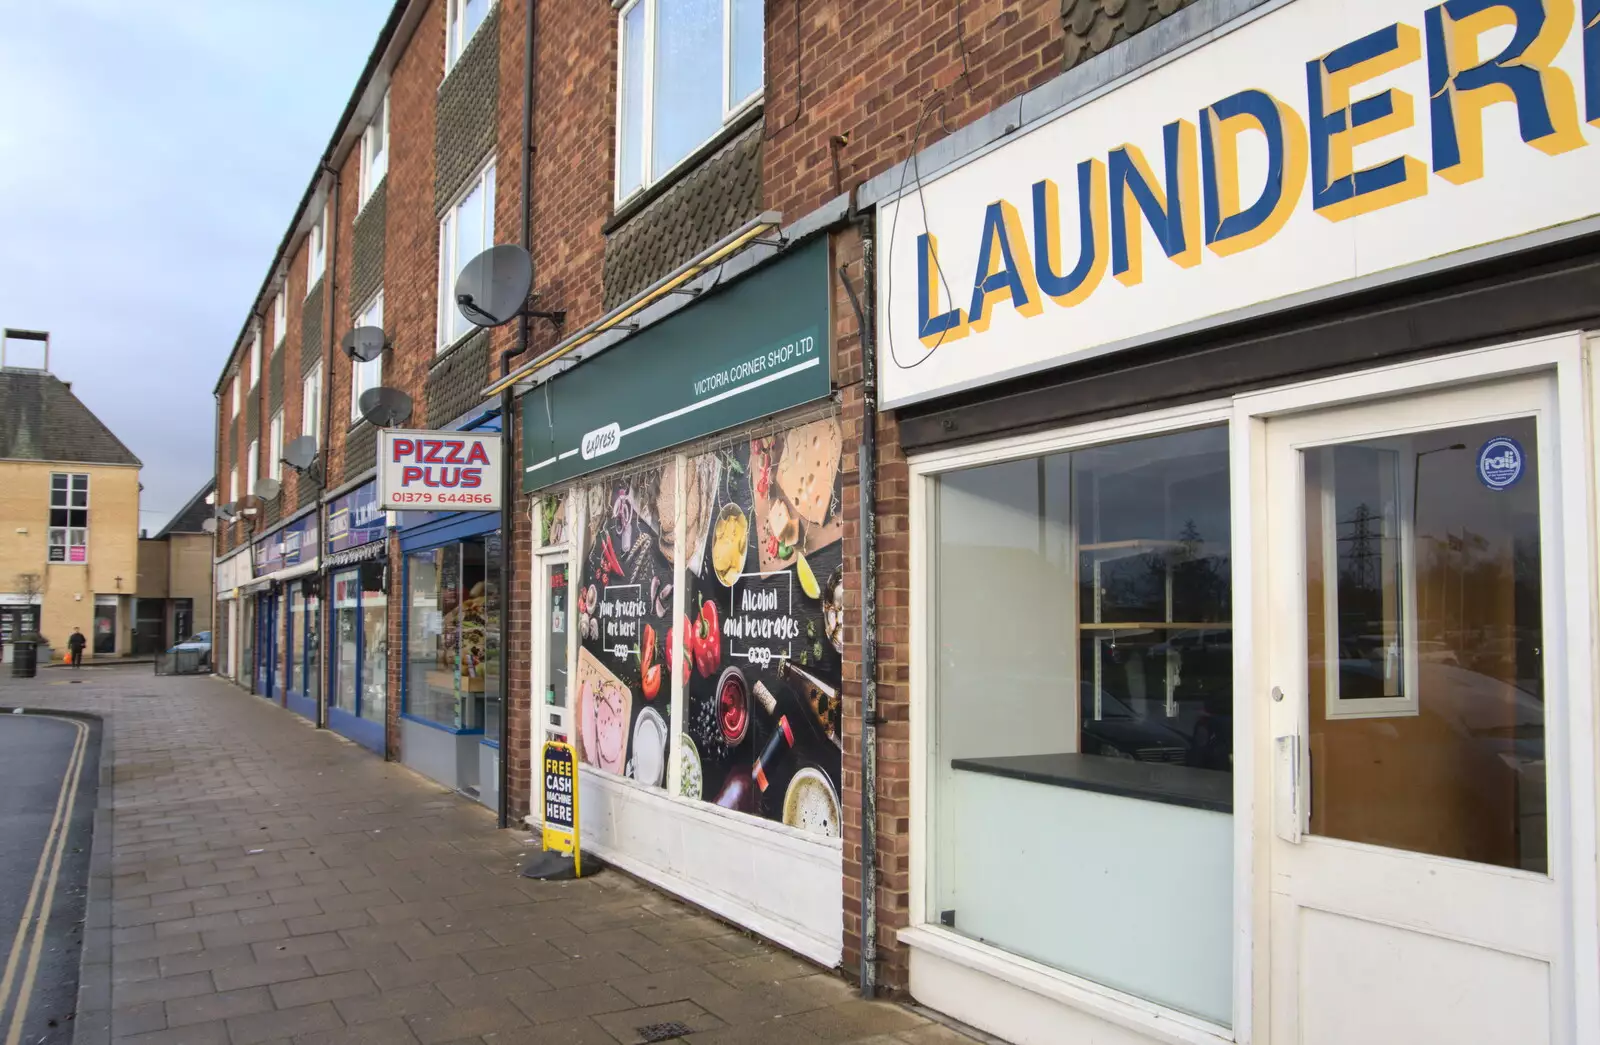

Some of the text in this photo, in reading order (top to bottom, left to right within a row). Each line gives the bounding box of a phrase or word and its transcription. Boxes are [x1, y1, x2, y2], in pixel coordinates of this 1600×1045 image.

[918, 0, 1600, 348] LAUNDER
[694, 336, 814, 396] VICTORIA CORNER SHOP LTD
[392, 438, 490, 465] PIZZA
[586, 430, 616, 457] express
[401, 466, 482, 488] PLUS
[392, 492, 492, 504] 01379 644366
[615, 598, 646, 618] groceries
[742, 588, 778, 612] Alcohol
[607, 621, 618, 636] are
[723, 614, 799, 640] and beverages
[546, 759, 571, 776] FREE
[546, 775, 572, 793] CASH
[546, 791, 572, 805] MACHINE
[546, 803, 572, 822] HERE
